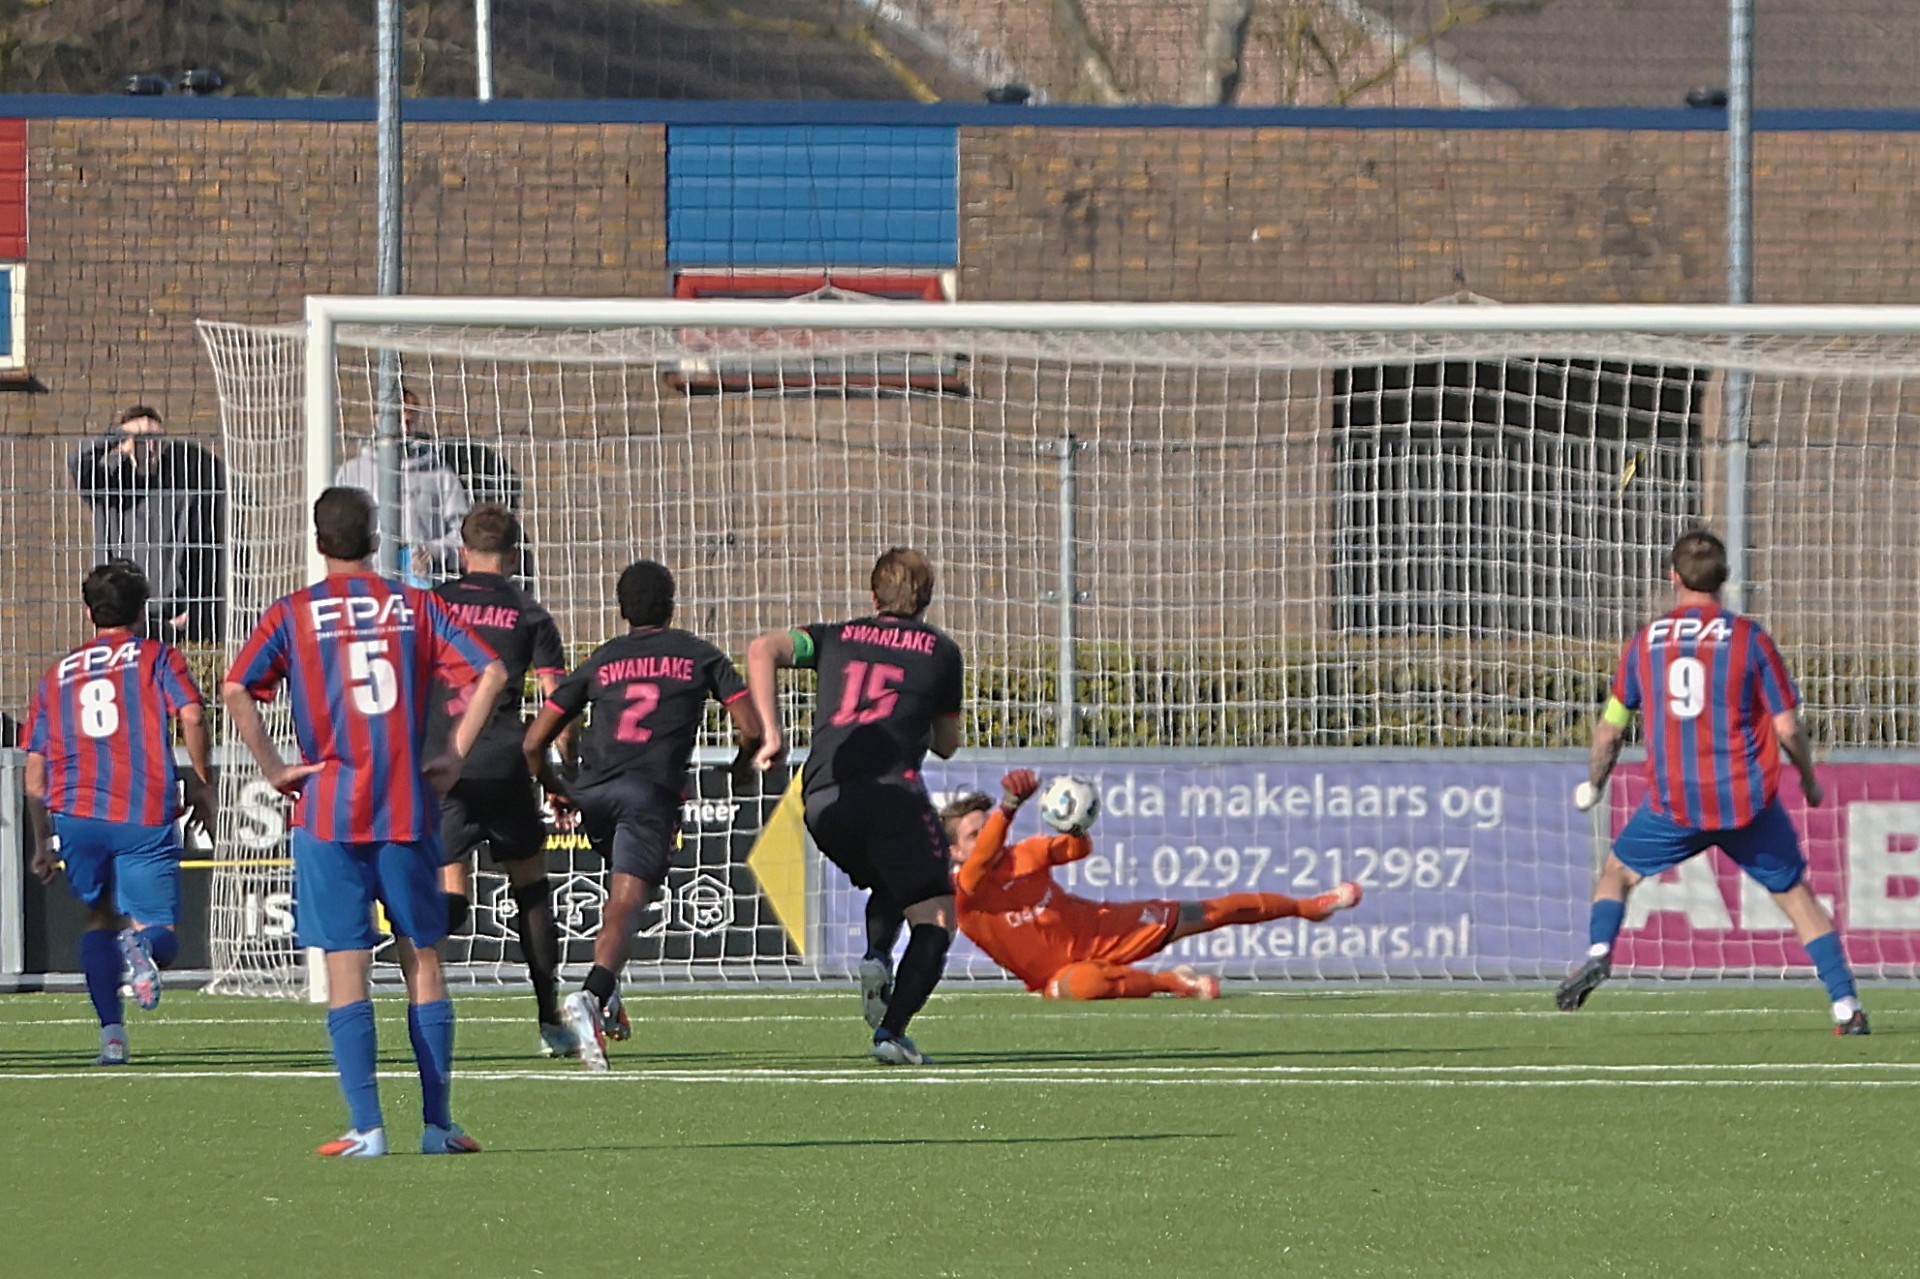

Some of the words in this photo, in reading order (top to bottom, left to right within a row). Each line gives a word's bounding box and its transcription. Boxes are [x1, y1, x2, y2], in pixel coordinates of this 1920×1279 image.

[447, 602, 520, 630] ANLAKE
[841, 624, 937, 654] SWANLAKE
[349, 639, 398, 715] 5
[599, 656, 695, 687] SWANLAKE
[830, 660, 905, 726] 15
[1669, 657, 1705, 717] 9
[79, 678, 119, 737] 8
[614, 683, 661, 743] 2
[1179, 773, 1427, 818] makelaars
[1441, 785, 1502, 829] og
[1152, 846, 1471, 888] 0297-212987
